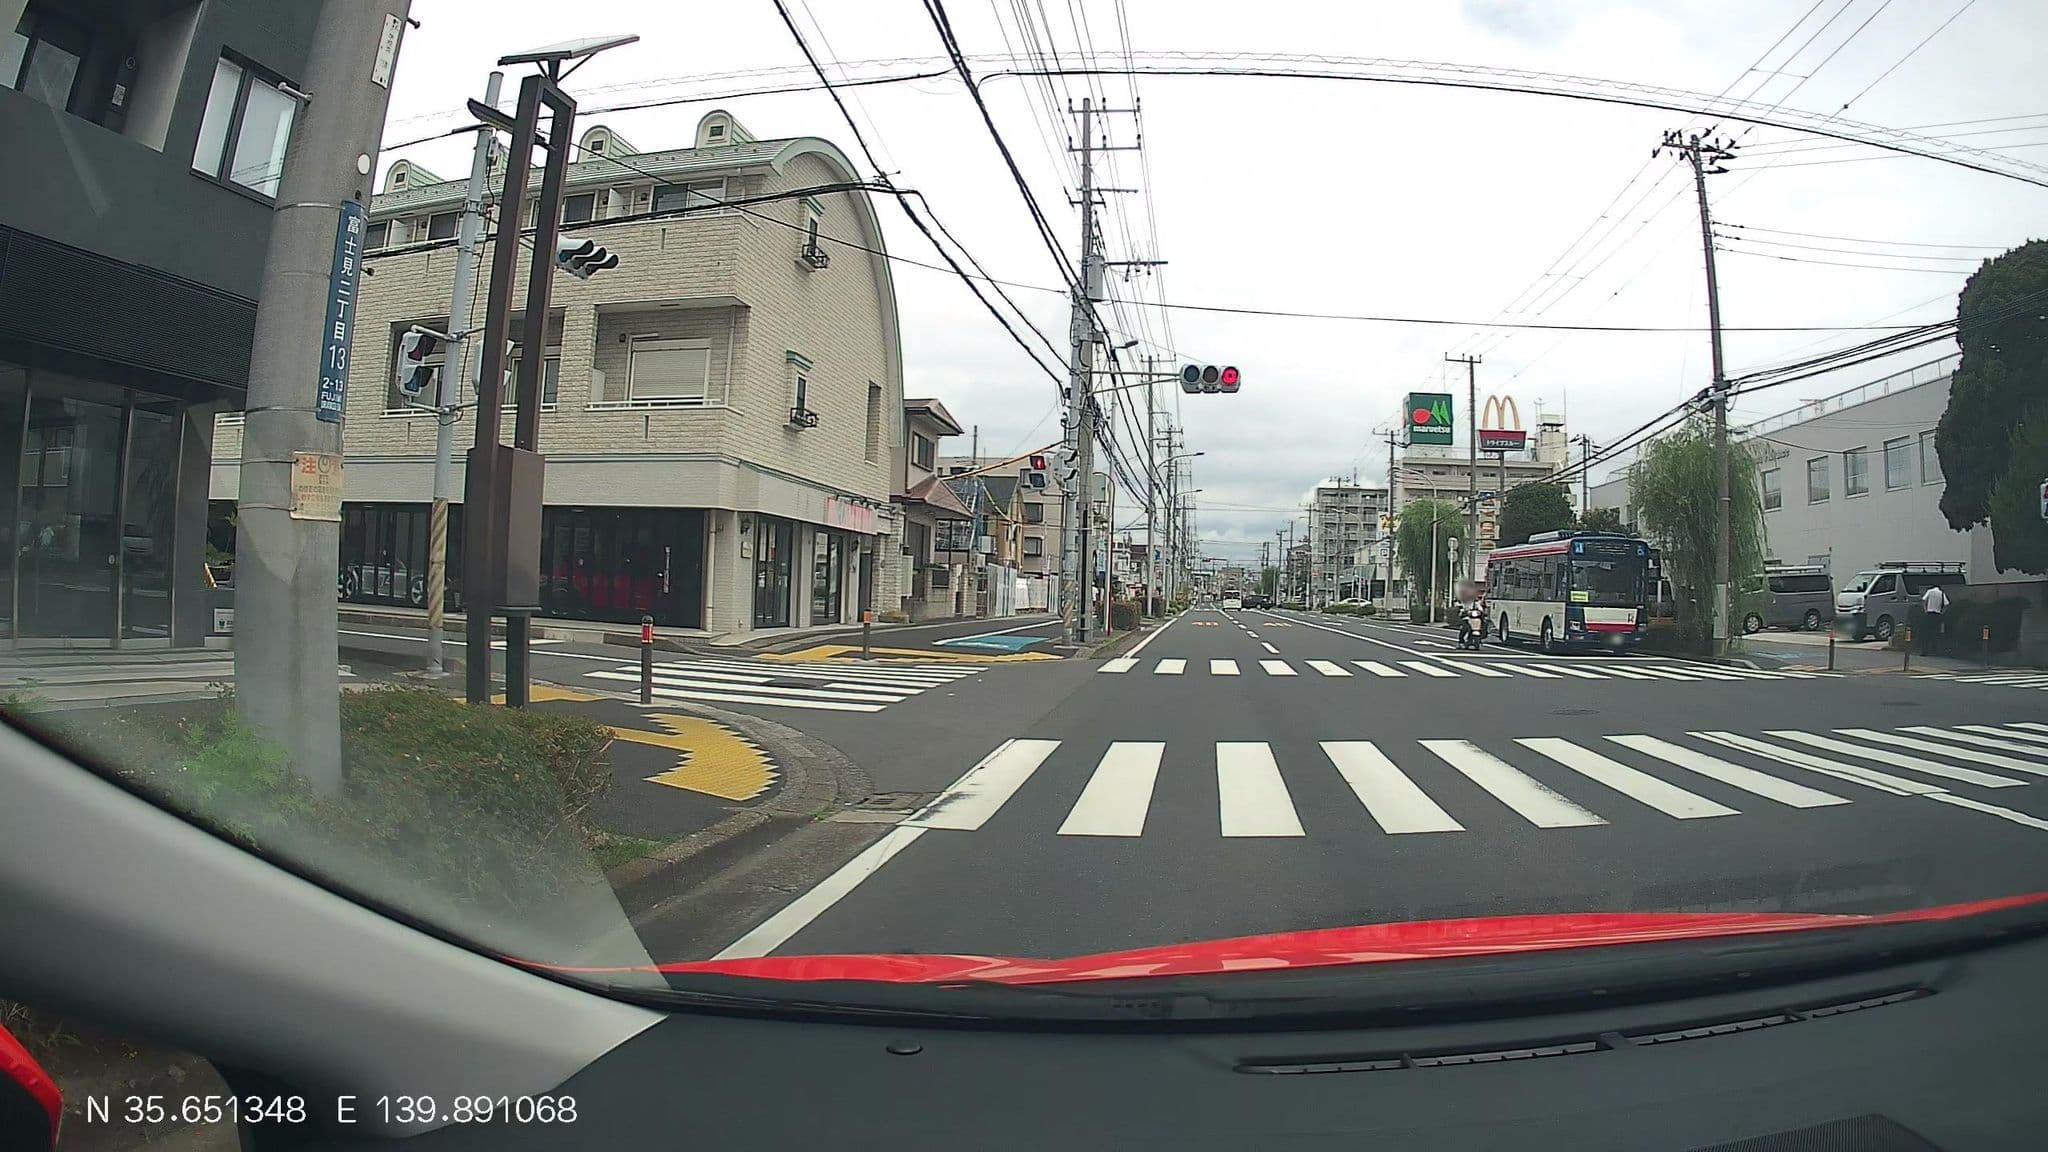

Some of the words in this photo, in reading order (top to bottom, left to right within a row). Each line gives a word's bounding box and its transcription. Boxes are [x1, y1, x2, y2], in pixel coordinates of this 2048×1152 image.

[333, 215, 360, 341] 富士見二丁目
[328, 345, 346, 370] 13
[322, 377, 344, 392] 2-13
